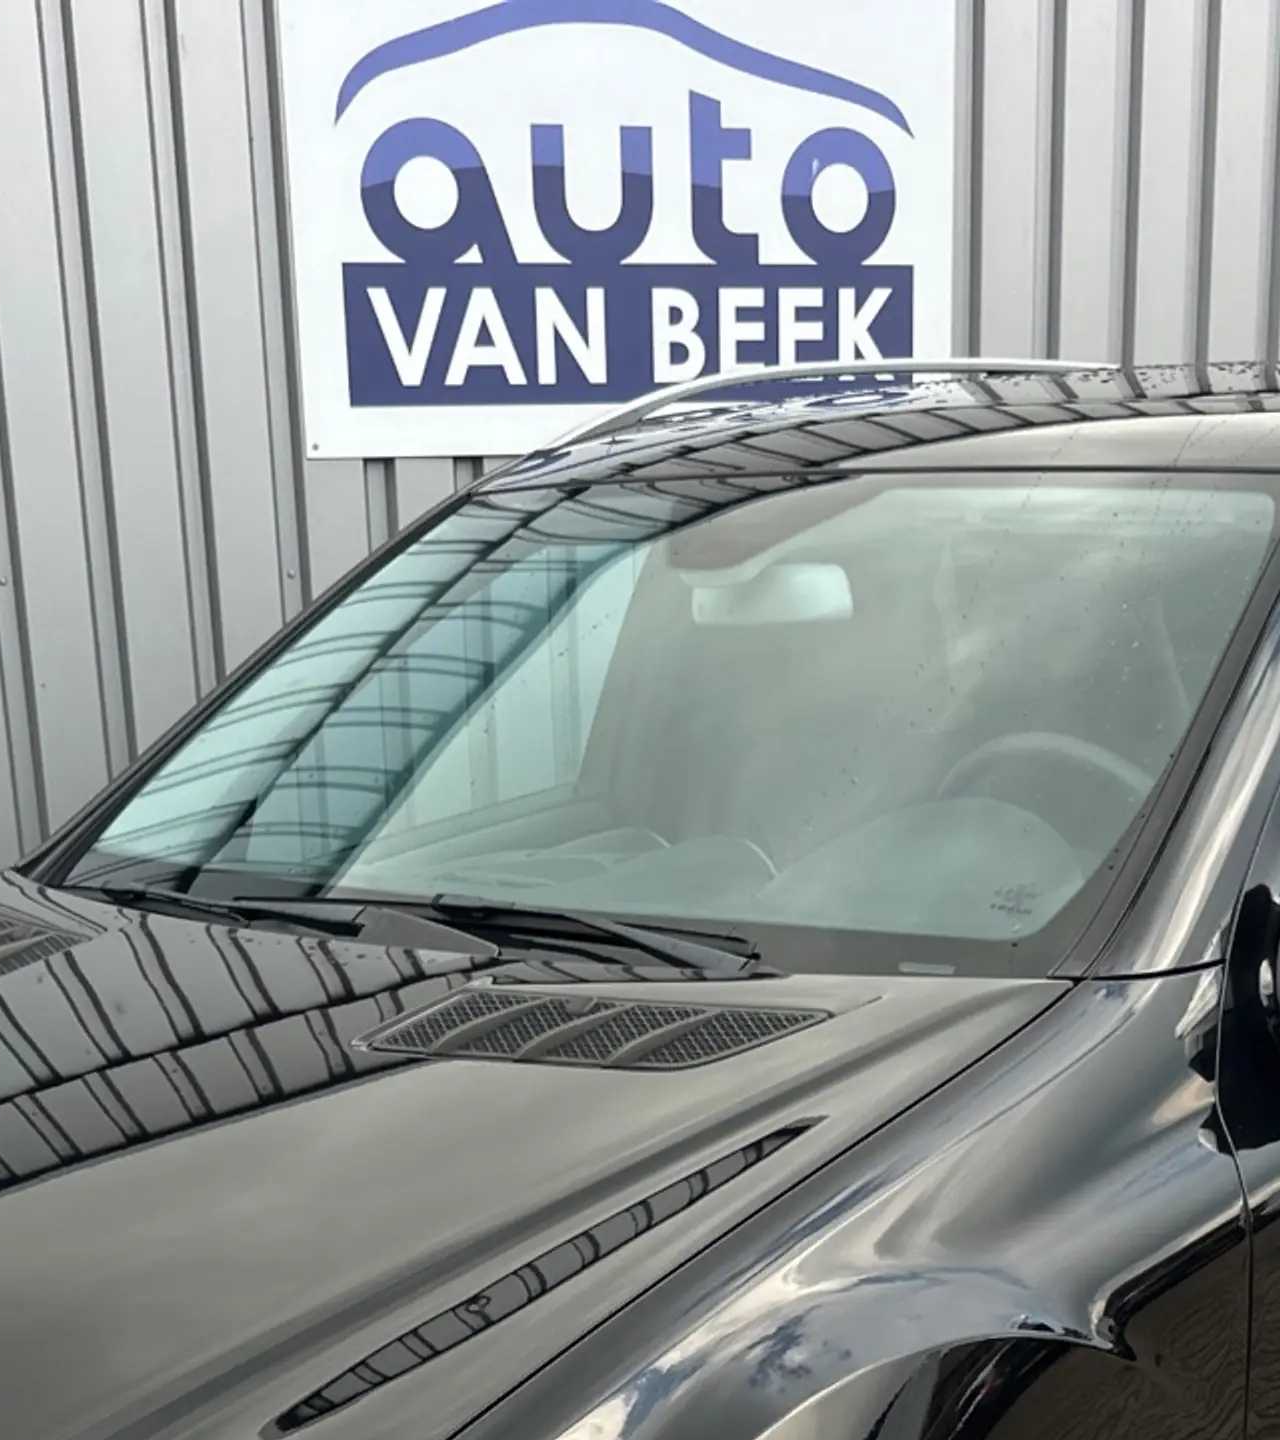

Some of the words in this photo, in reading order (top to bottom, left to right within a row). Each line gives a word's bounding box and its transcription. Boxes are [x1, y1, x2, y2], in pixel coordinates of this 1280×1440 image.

[360, 89, 897, 264] auto
[366, 287, 607, 387] VAN
[652, 287, 894, 384] BEEK
